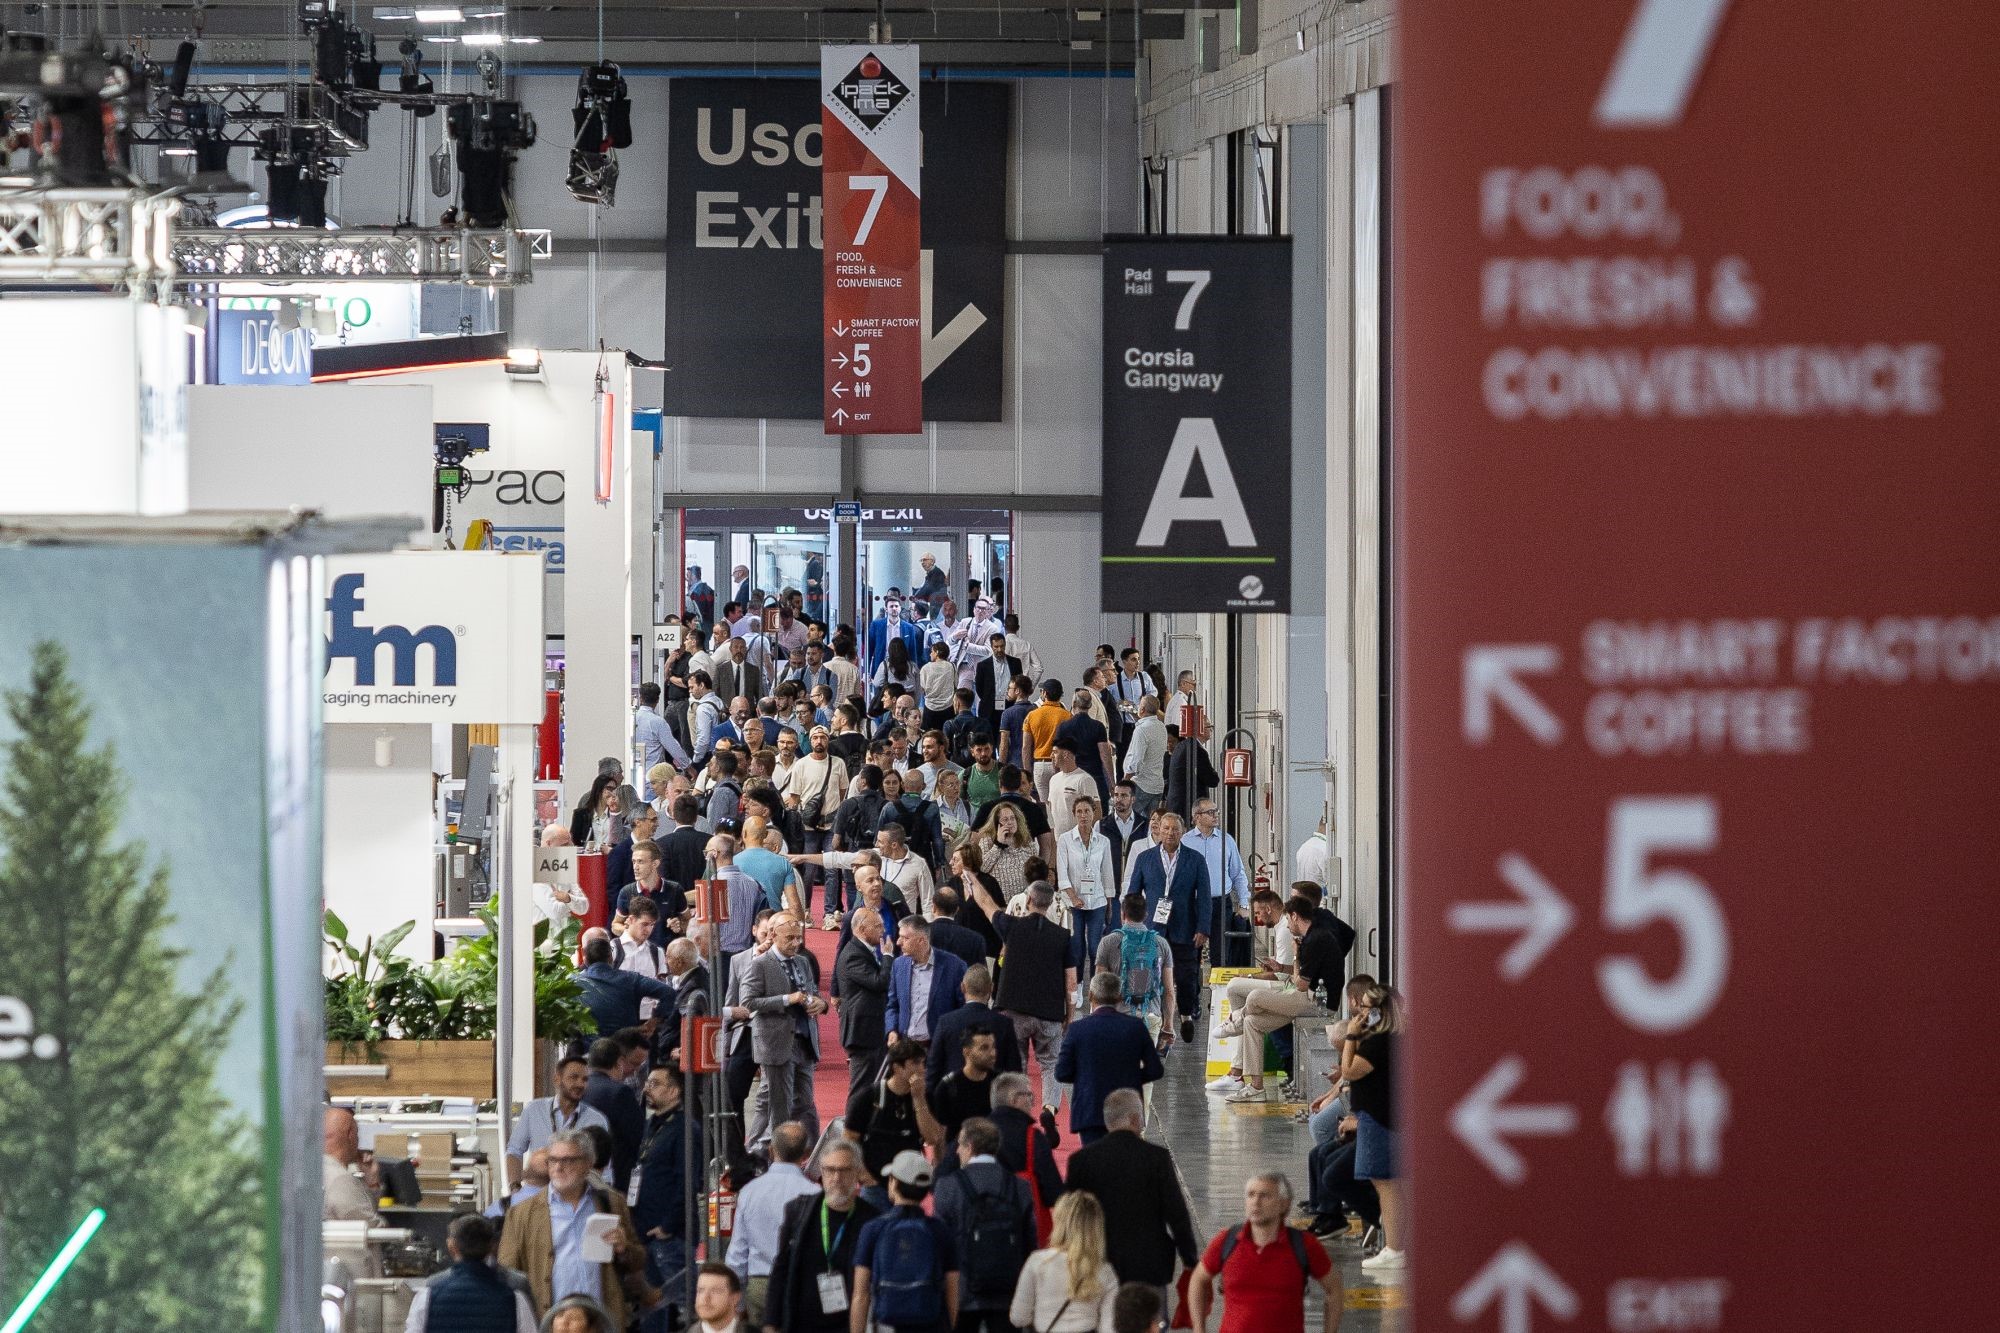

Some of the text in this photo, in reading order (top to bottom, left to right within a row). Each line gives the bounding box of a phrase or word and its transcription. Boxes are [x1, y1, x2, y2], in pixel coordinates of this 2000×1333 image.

[840, 82, 902, 98] ipack
[853, 95, 890, 109] ima
[695, 190, 824, 250] Exit
[848, 175, 889, 246] 7
[1480, 167, 1681, 247] FOOD,
[836, 252, 865, 263] FOOD,
[836, 265, 877, 274] FRESH &
[836, 278, 902, 288] CONVENIENCE
[1124, 282, 1153, 295] Hall
[1480, 254, 1760, 330] FRESH &
[1124, 268, 1211, 331] Pad 7
[851, 318, 920, 327] SMART FACTORY
[851, 328, 883, 337] COFFEE
[852, 343, 872, 377] 5
[1124, 347, 1195, 367] Corsia
[1124, 368, 1224, 392] Gangway
[1480, 343, 1944, 421] CONVENIENCE
[1135, 417, 1258, 547] A
[321, 573, 457, 687] fm
[657, 633, 675, 641] A22
[1585, 618, 1786, 683] SMART
[373, 690, 457, 707] machinery
[1585, 689, 1812, 755] COFFEE
[540, 858, 569, 871] A64
[1599, 796, 1732, 1034] 5
[1606, 1276, 1733, 1332] EXIT
